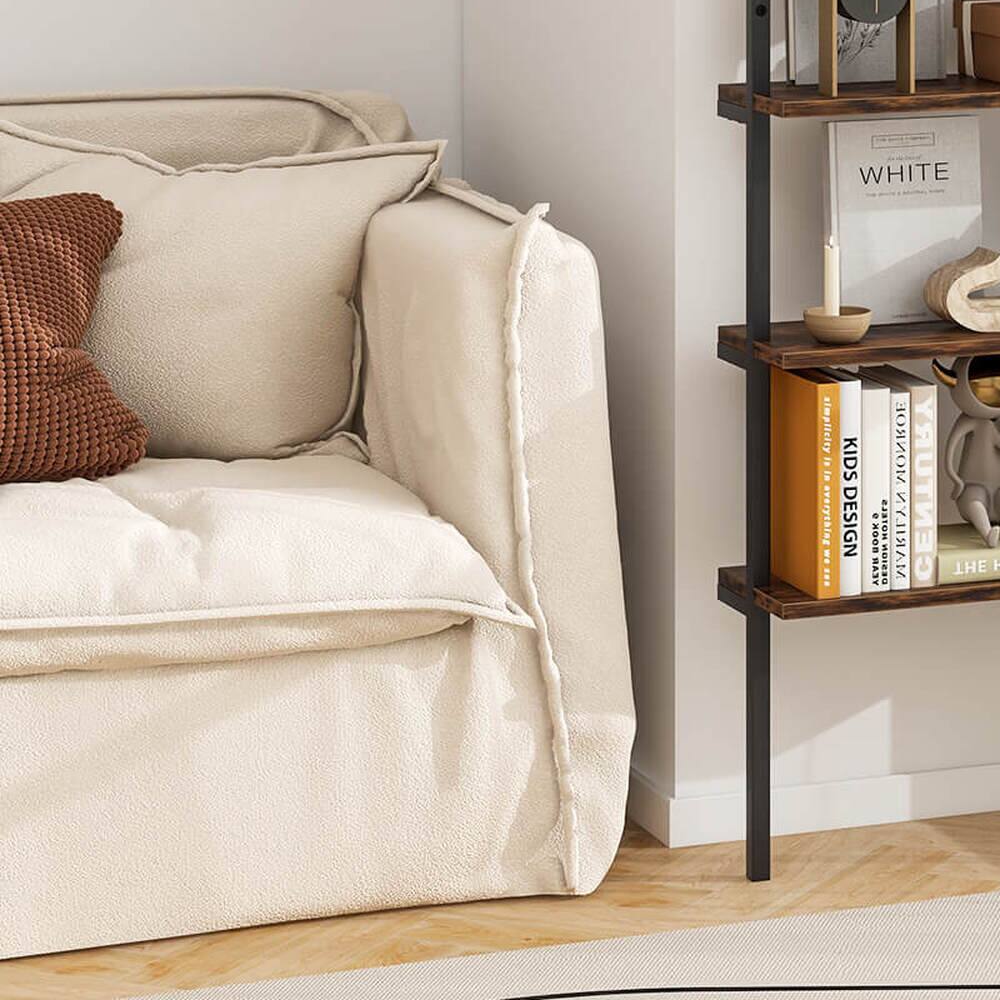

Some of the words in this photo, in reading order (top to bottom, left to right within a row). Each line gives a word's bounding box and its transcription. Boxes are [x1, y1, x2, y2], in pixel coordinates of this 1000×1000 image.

[859, 161, 950, 185] WHITE
[822, 396, 833, 453] simplicity
[843, 437, 858, 482] KIDS
[843, 487, 858, 557] DESIGN
